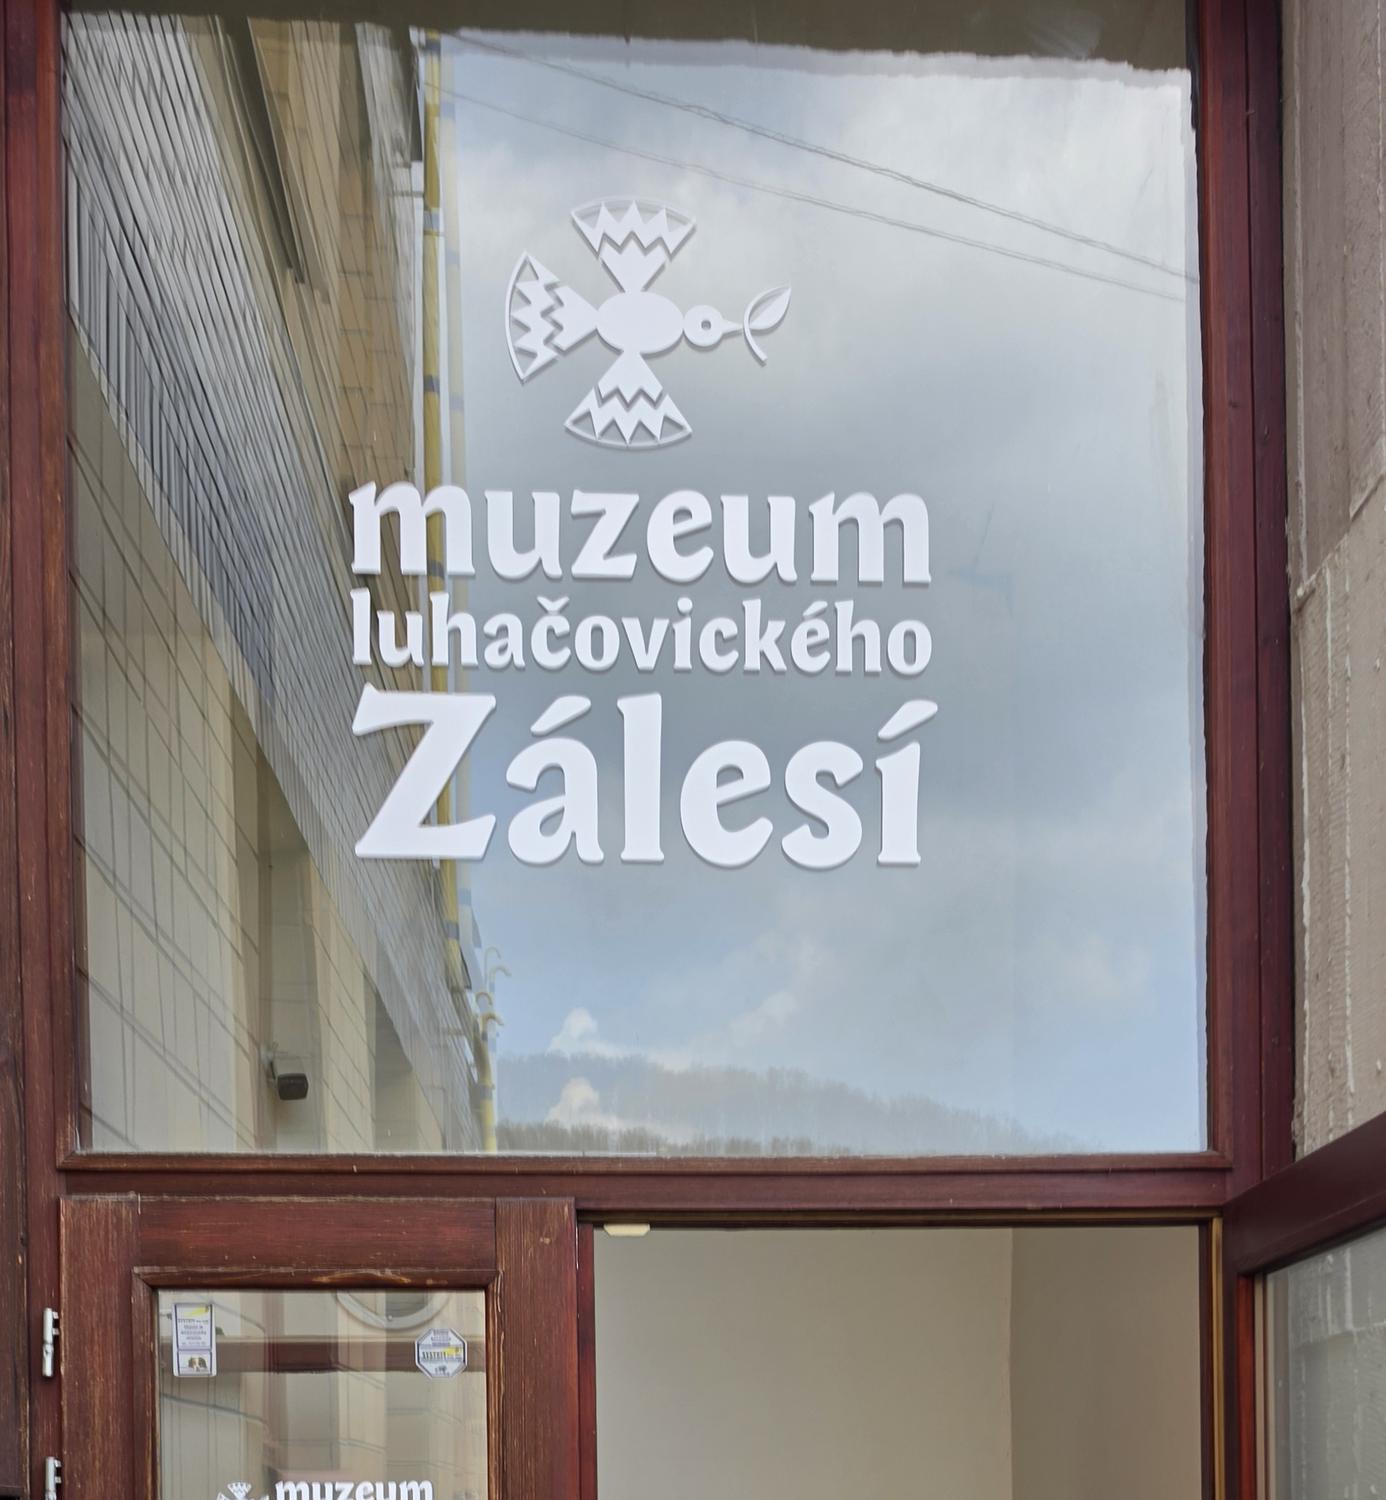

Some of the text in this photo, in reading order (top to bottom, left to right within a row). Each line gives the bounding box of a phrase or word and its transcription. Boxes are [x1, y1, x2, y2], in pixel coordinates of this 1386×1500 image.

[348, 481, 932, 584] muzeum
[350, 587, 933, 675] luhačovického
[352, 682, 938, 869] Zálesí
